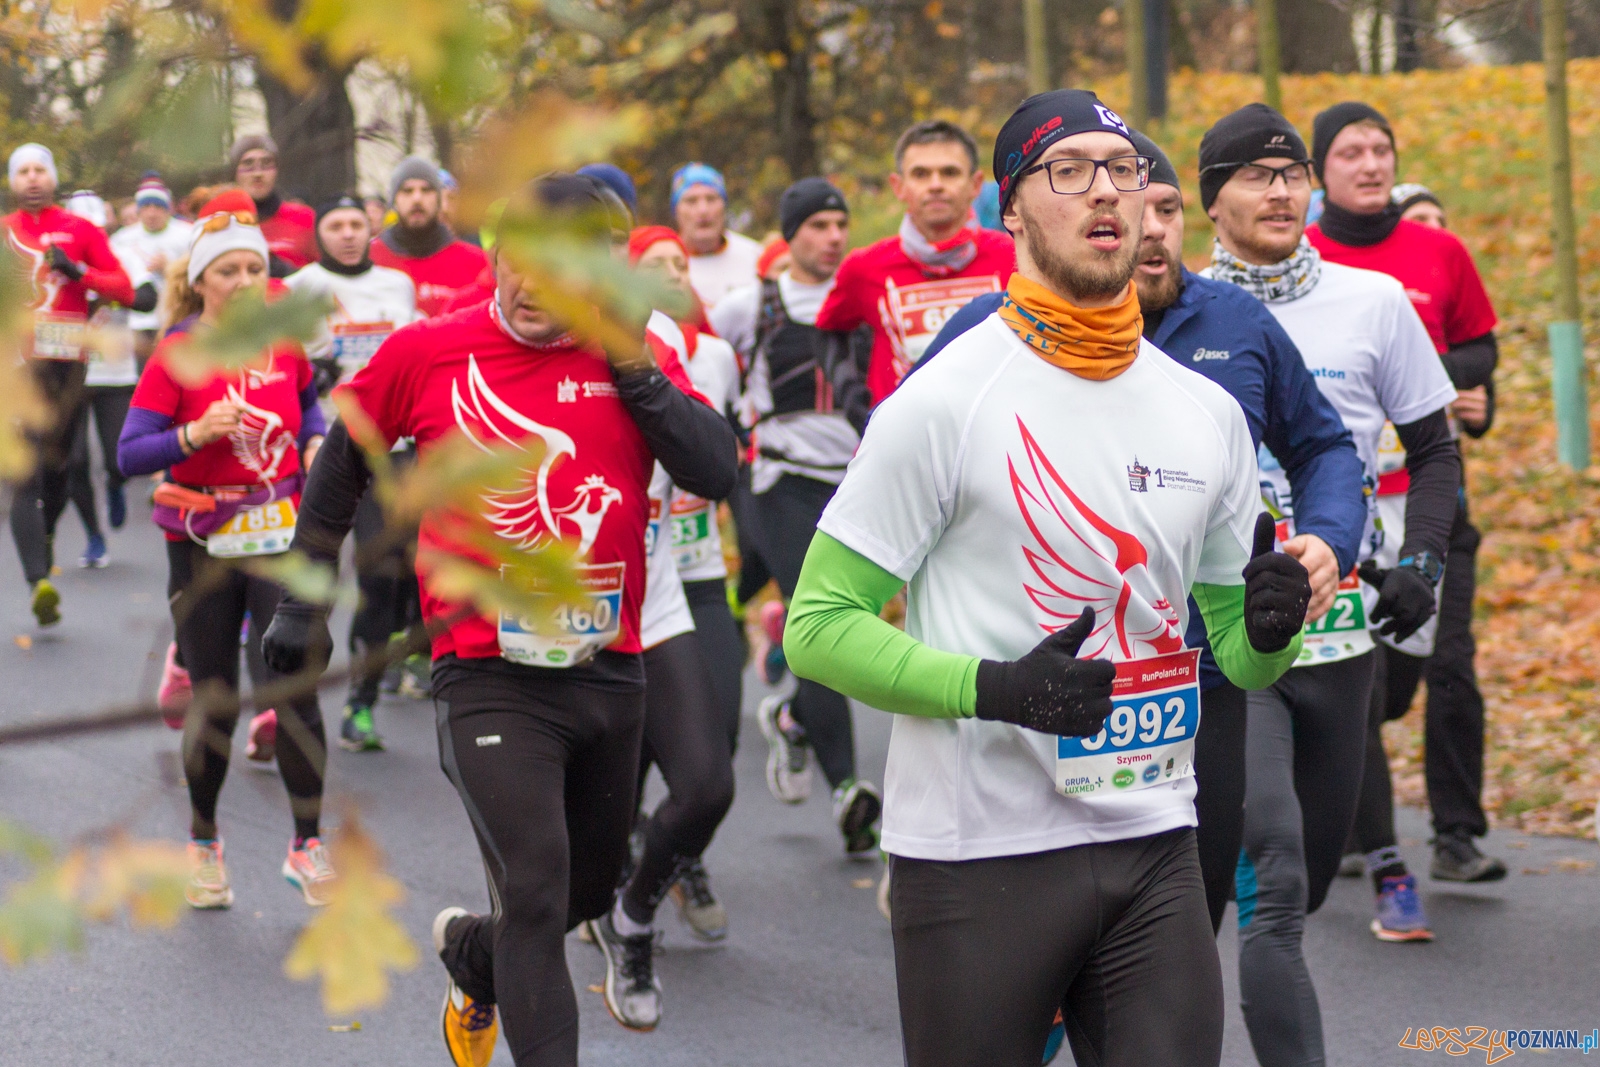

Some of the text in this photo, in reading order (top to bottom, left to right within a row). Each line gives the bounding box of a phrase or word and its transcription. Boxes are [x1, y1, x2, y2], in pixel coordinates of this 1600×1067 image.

[1022, 115, 1063, 156] bike
[1308, 367, 1345, 379] aton
[1155, 468, 1165, 487] 1
[1141, 666, 1190, 682] RunPoland.org
[1116, 753, 1152, 765] Szymon
[1065, 776, 1090, 787] GRUPA
[1065, 784, 1095, 794] LUXMED
